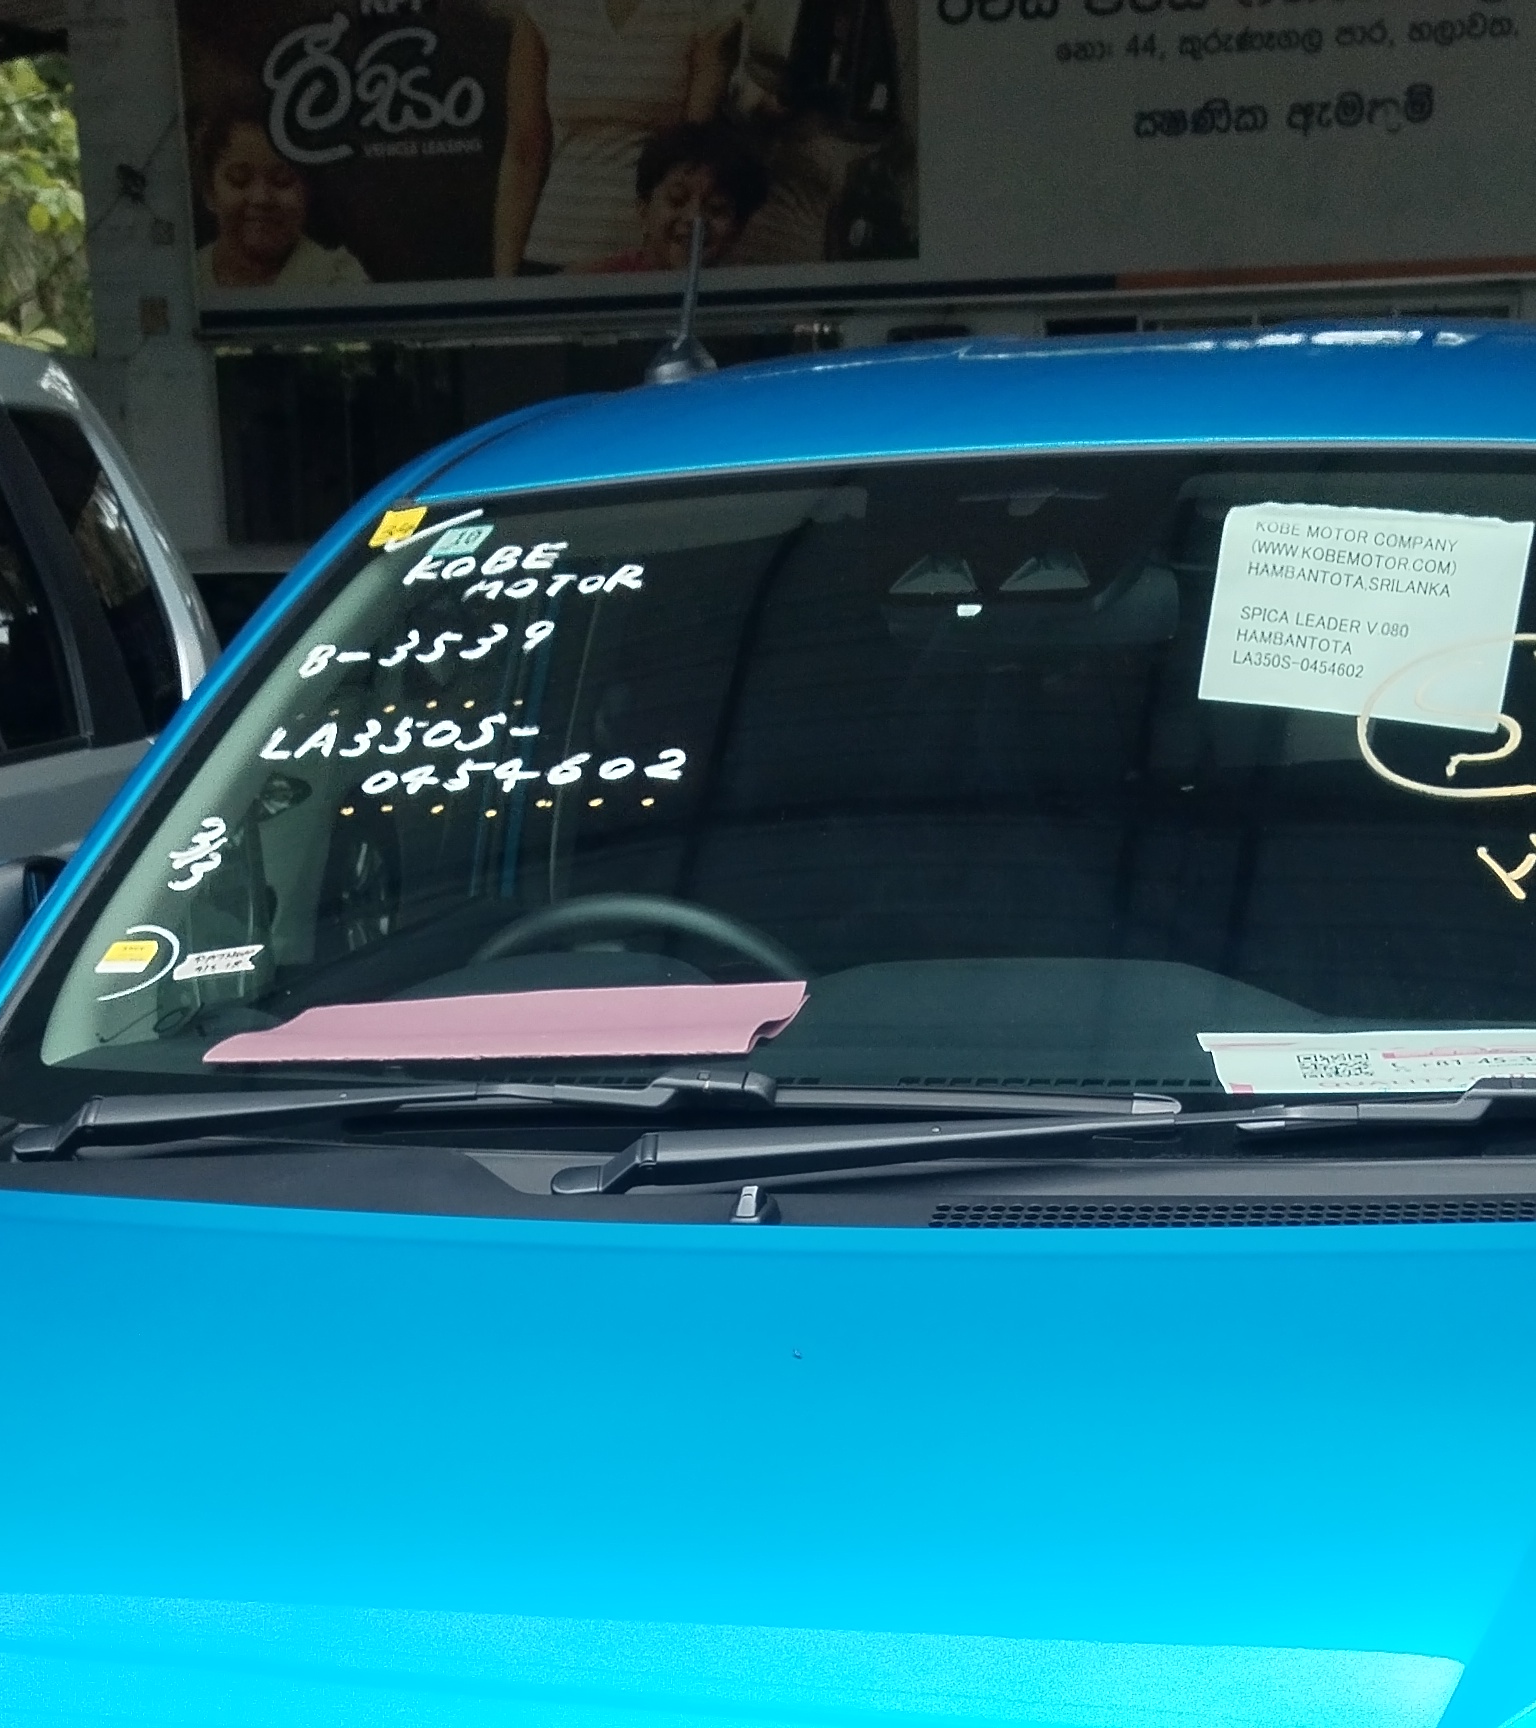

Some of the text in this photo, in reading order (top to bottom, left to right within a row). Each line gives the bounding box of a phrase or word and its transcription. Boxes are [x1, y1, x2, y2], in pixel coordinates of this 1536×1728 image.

[1124, 30, 1167, 62] 44,
[1256, 520, 1459, 553] KOBE MOTOR COMPANY
[403, 542, 568, 585] KOBE
[1252, 539, 1457, 577] (WWW.KOBEMOTOR.COM)
[460, 564, 645, 602] MOTOR
[1240, 606, 1290, 625] SPICA
[1295, 612, 1361, 635] LEADER
[1236, 628, 1353, 656] HAMBANTOTA
[1233, 650, 1365, 679] LA350S-0454602
[362, 748, 688, 794] 0454602
